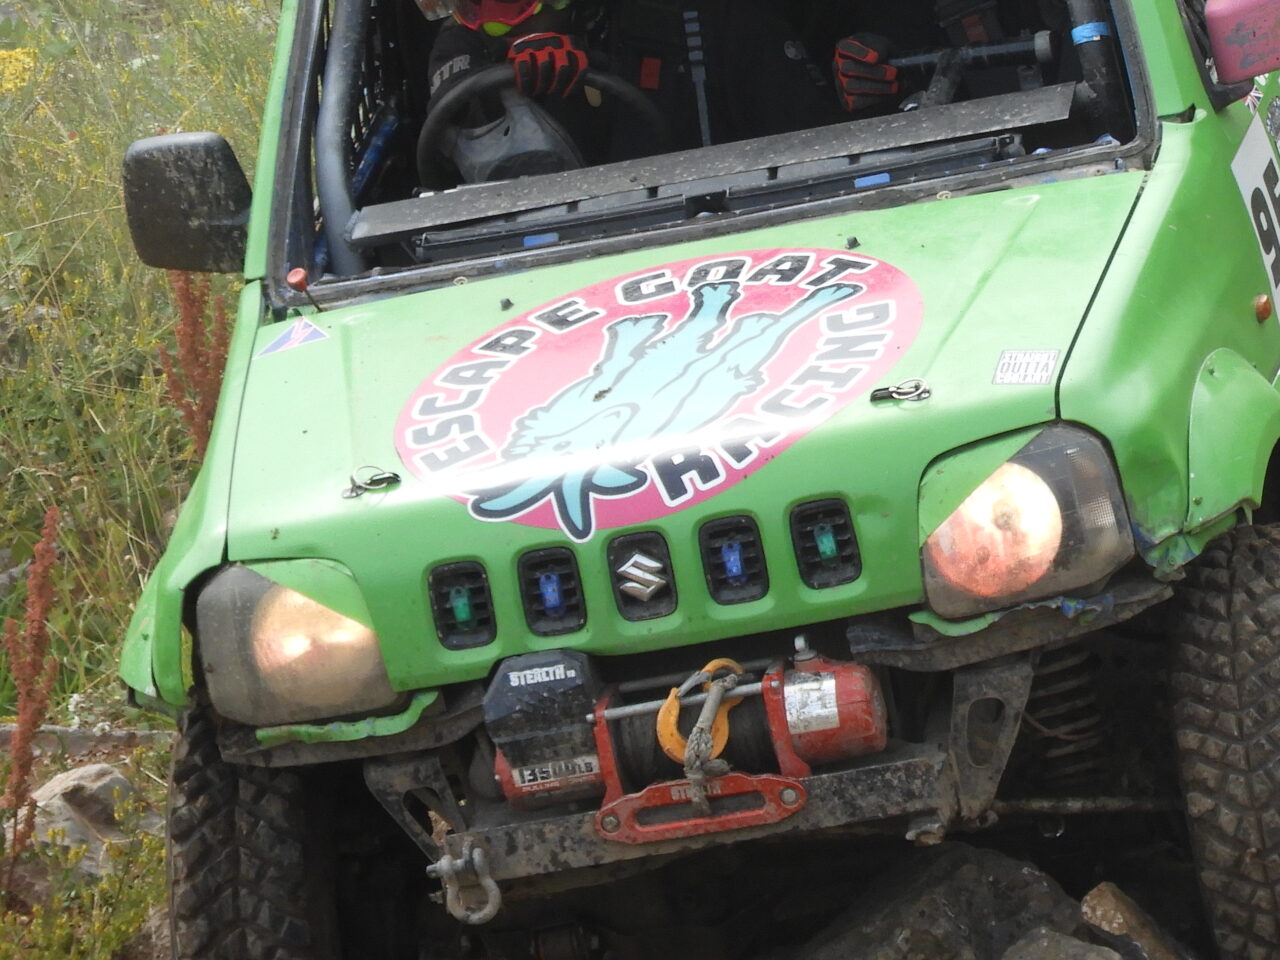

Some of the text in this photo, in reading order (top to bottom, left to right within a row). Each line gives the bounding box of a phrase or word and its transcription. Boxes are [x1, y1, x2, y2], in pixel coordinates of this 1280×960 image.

[1000, 361, 1049, 374] OUTTA
[414, 252, 899, 507] ESCAPE GOAT RACING
[508, 664, 566, 687] STEALTH
